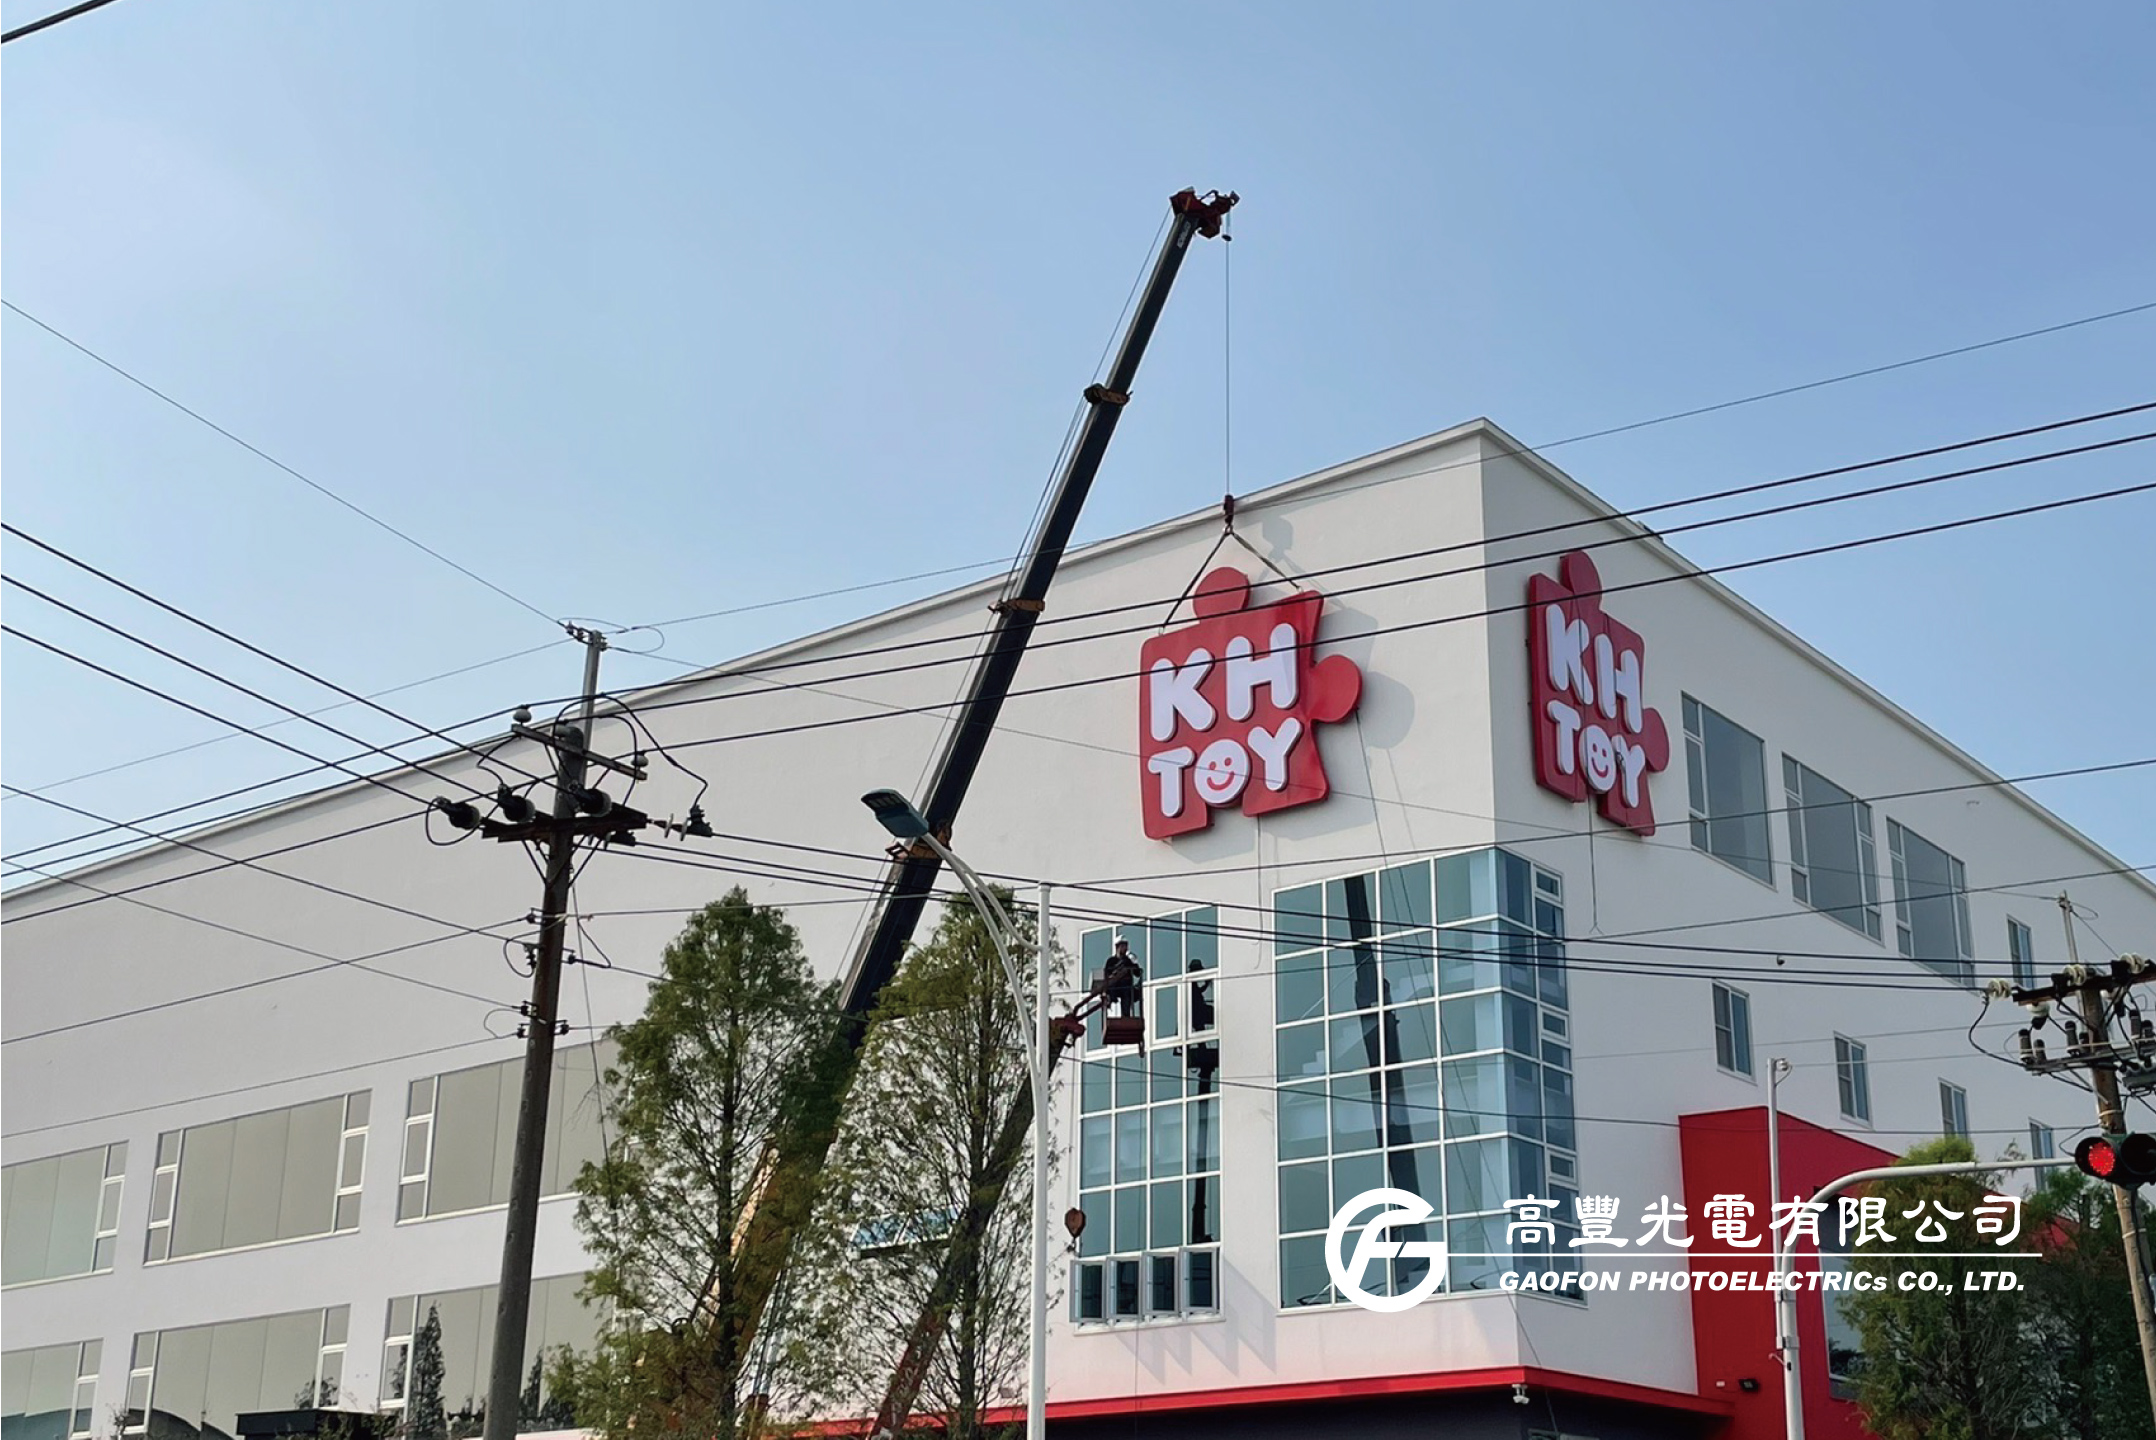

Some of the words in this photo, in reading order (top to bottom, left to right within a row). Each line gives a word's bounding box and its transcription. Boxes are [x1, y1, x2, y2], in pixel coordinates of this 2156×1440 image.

[1148, 622, 1300, 742] KH
[1546, 604, 1643, 733] KH
[1147, 717, 1303, 818] TOY
[1547, 700, 1645, 808] TOY
